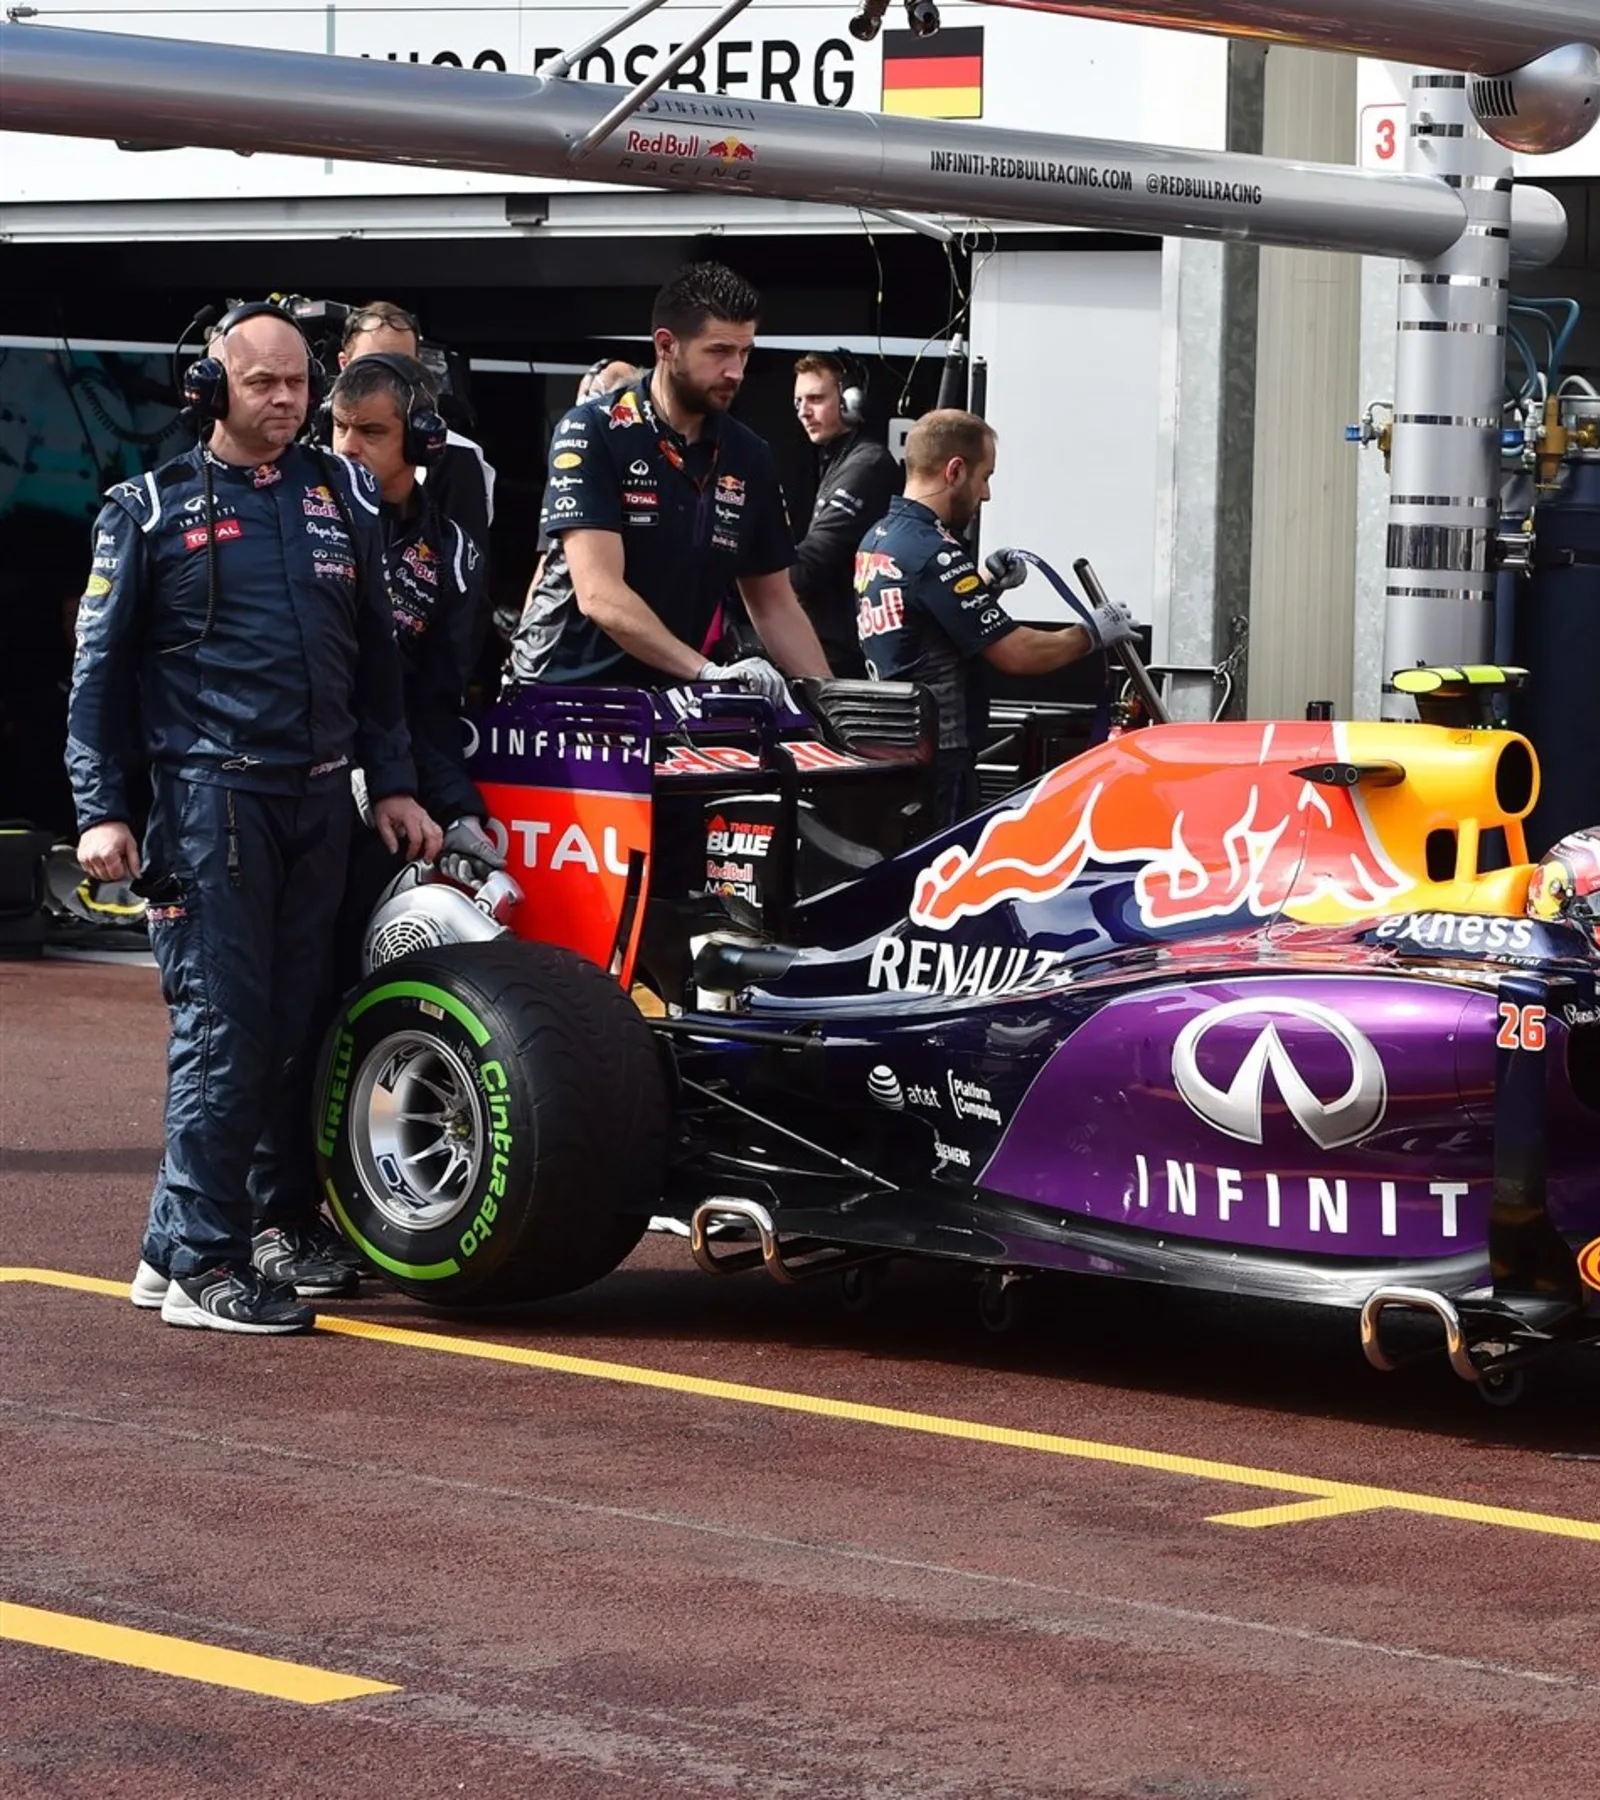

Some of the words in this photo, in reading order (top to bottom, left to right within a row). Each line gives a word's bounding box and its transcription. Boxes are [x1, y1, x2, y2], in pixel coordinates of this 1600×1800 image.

[666, 103, 756, 121] INFINITI
[626, 130, 663, 154] Red
[664, 134, 700, 157] Bull
[1375, 119, 1396, 159] 3
[617, 158, 753, 181] RACING
[930, 150, 1133, 192] INFINITI-REDBULLRACING.COM
[1146, 172, 1263, 205] @REDBULLRACING
[624, 492, 659, 505] TOTAL
[180, 506, 236, 528] INFIITI
[188, 525, 240, 544] TOAL
[857, 588, 904, 641] Bull
[491, 727, 650, 766] INFINITI
[726, 861, 754, 883] Bull
[1376, 912, 1535, 950] exness
[867, 936, 1067, 996] RENAULT
[1497, 1002, 1546, 1051] 26
[906, 1083, 942, 1109] at&t
[953, 1079, 992, 1102] Platform
[957, 1097, 1002, 1126] Computing
[460, 1060, 513, 1255] Cinturato
[934, 1141, 971, 1168] SIEMENS
